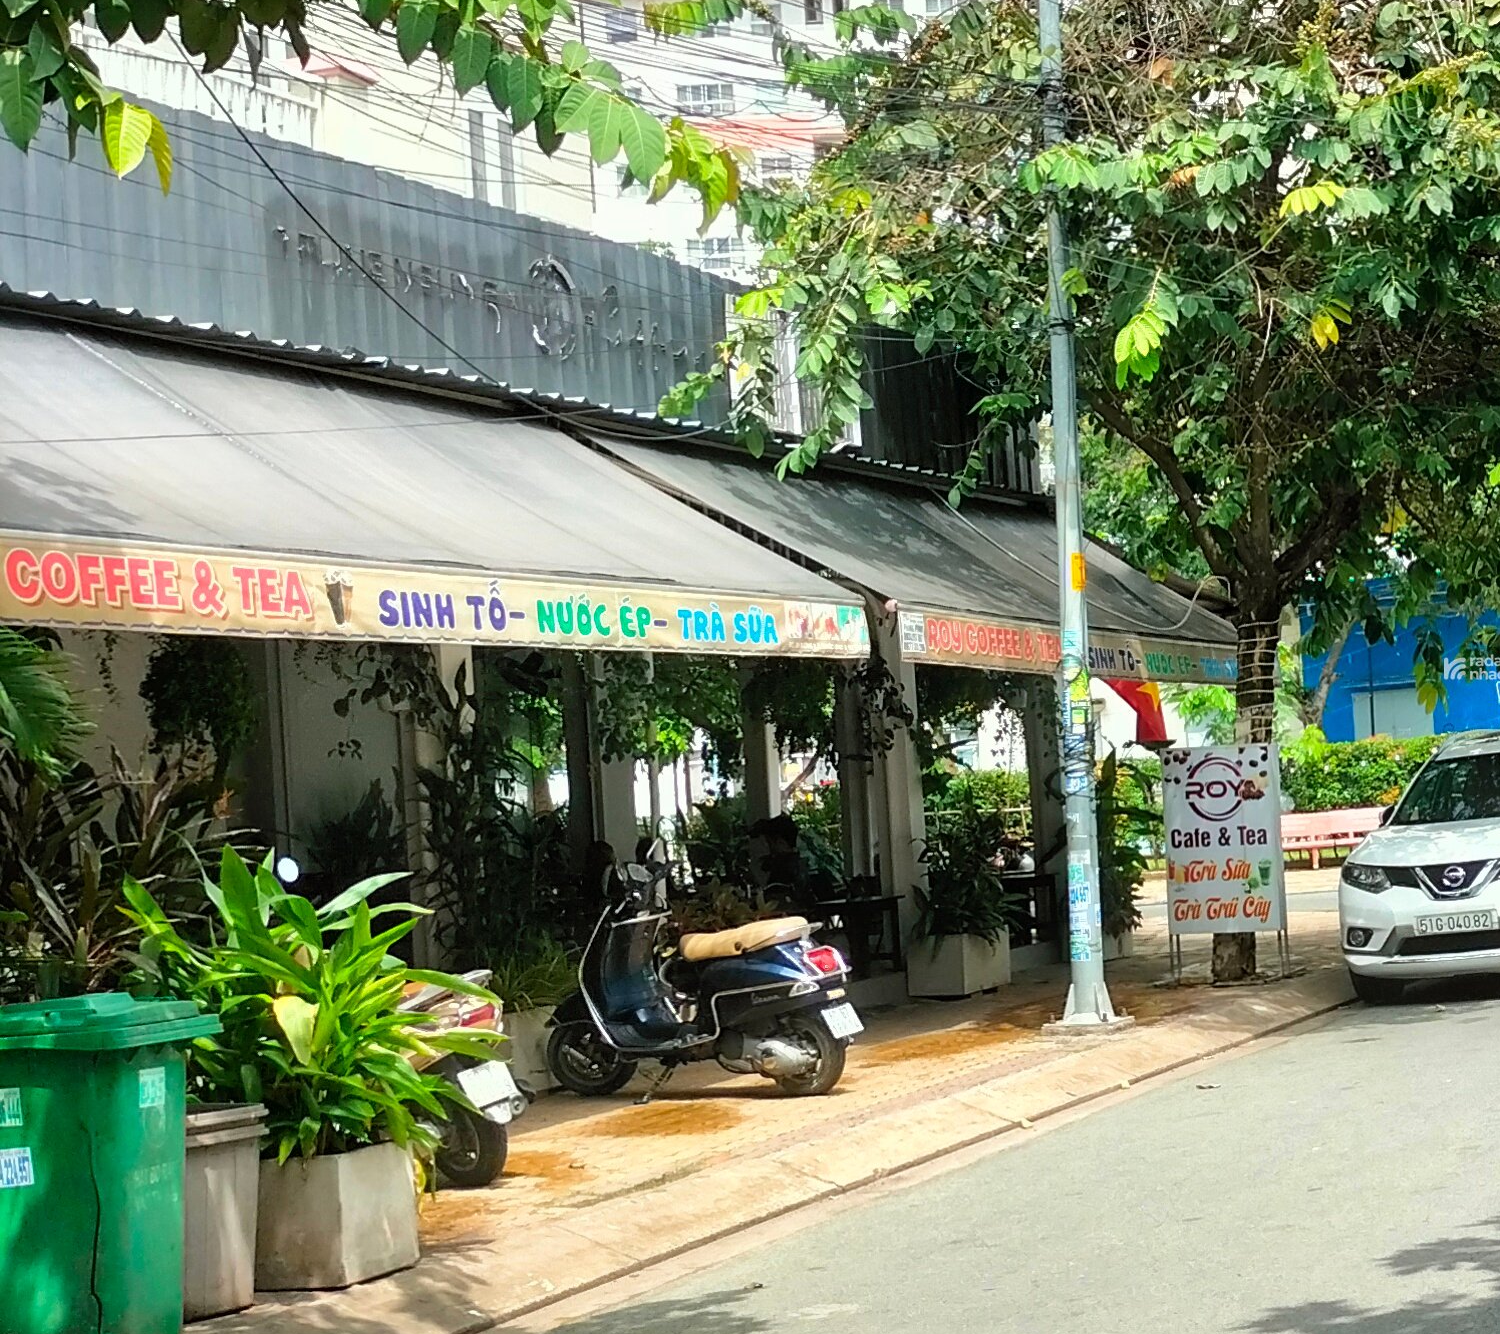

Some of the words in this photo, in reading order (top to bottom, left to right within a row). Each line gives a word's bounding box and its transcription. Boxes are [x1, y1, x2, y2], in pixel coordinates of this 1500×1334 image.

[5, 548, 182, 610] COFFEE
[192, 559, 227, 616] &
[232, 566, 312, 618] TEA
[379, 590, 455, 629] SINH
[536, 593, 612, 637] NƯỚC
[677, 603, 726, 642] TRÀ
[733, 606, 779, 645] SỮA
[926, 618, 963, 654] ROY
[966, 623, 1022, 660] COFFEE
[1023, 628, 1035, 661] &
[1088, 646, 1117, 670] SINH
[1186, 779, 1244, 800] ROY
[1171, 828, 1211, 849] Cafe
[1218, 827, 1231, 847] &
[1237, 826, 1268, 846] Tea
[1189, 859, 1218, 883] Trà
[1173, 898, 1202, 922] Trà
[1206, 897, 1238, 921] Trái
[1242, 896, 1272, 924] Cây
